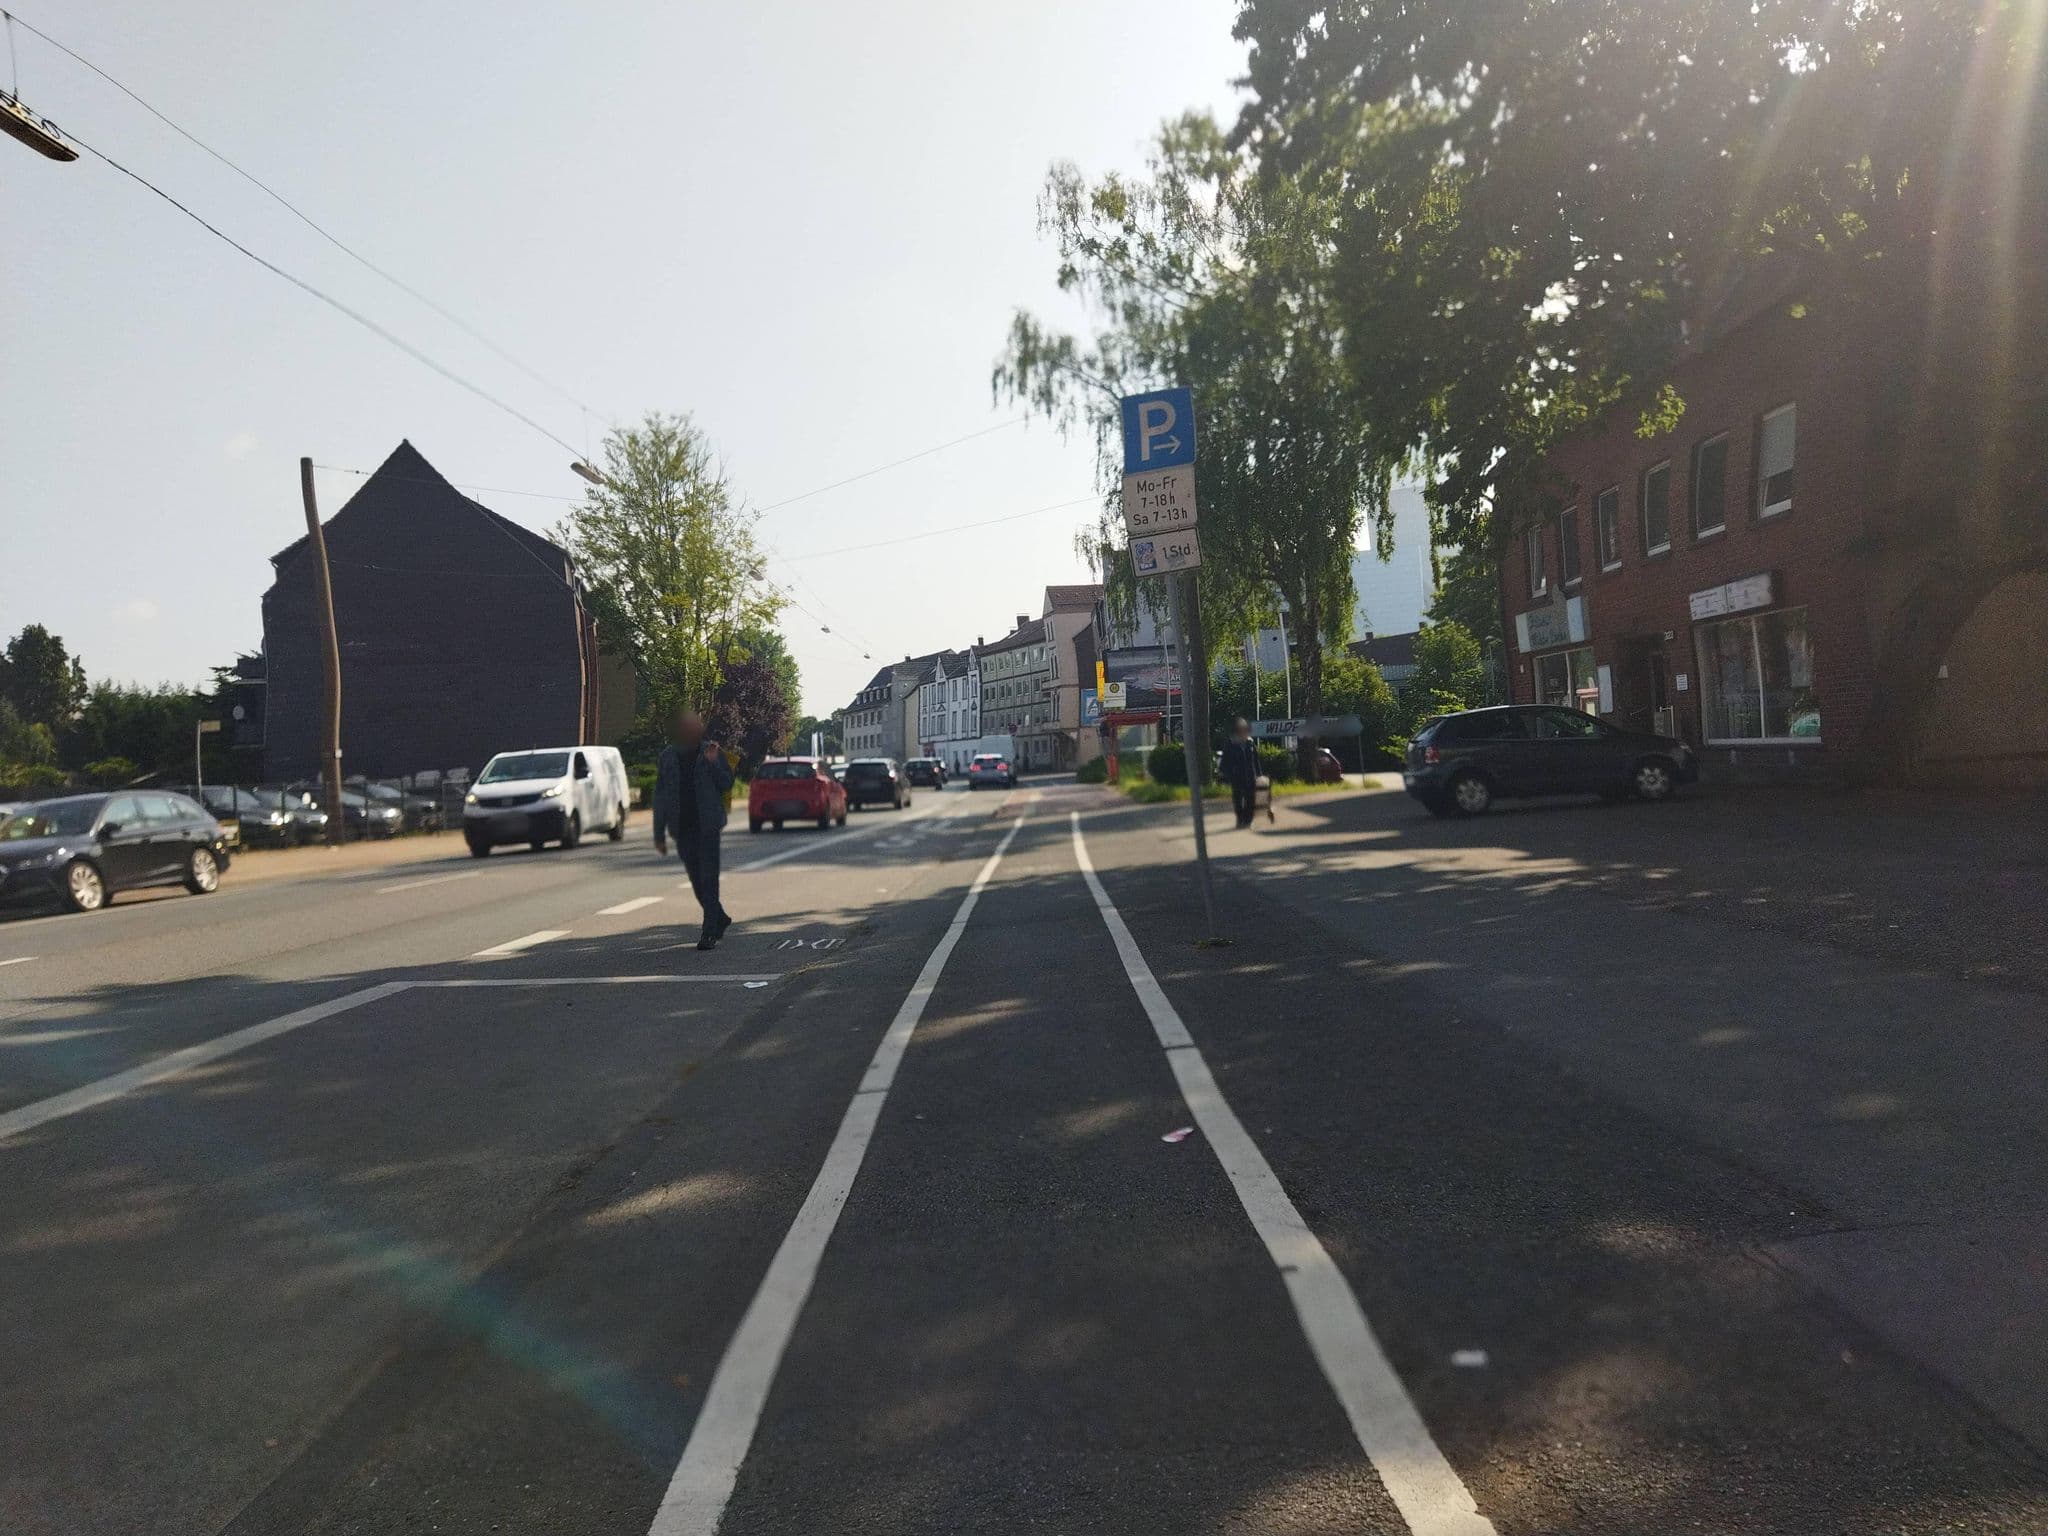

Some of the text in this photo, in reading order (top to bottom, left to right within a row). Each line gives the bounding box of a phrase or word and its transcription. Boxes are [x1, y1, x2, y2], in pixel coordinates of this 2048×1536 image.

[1138, 400, 1177, 462] P
[1137, 476, 1177, 494] Mo-Fr
[1133, 513, 1149, 526] Sa
